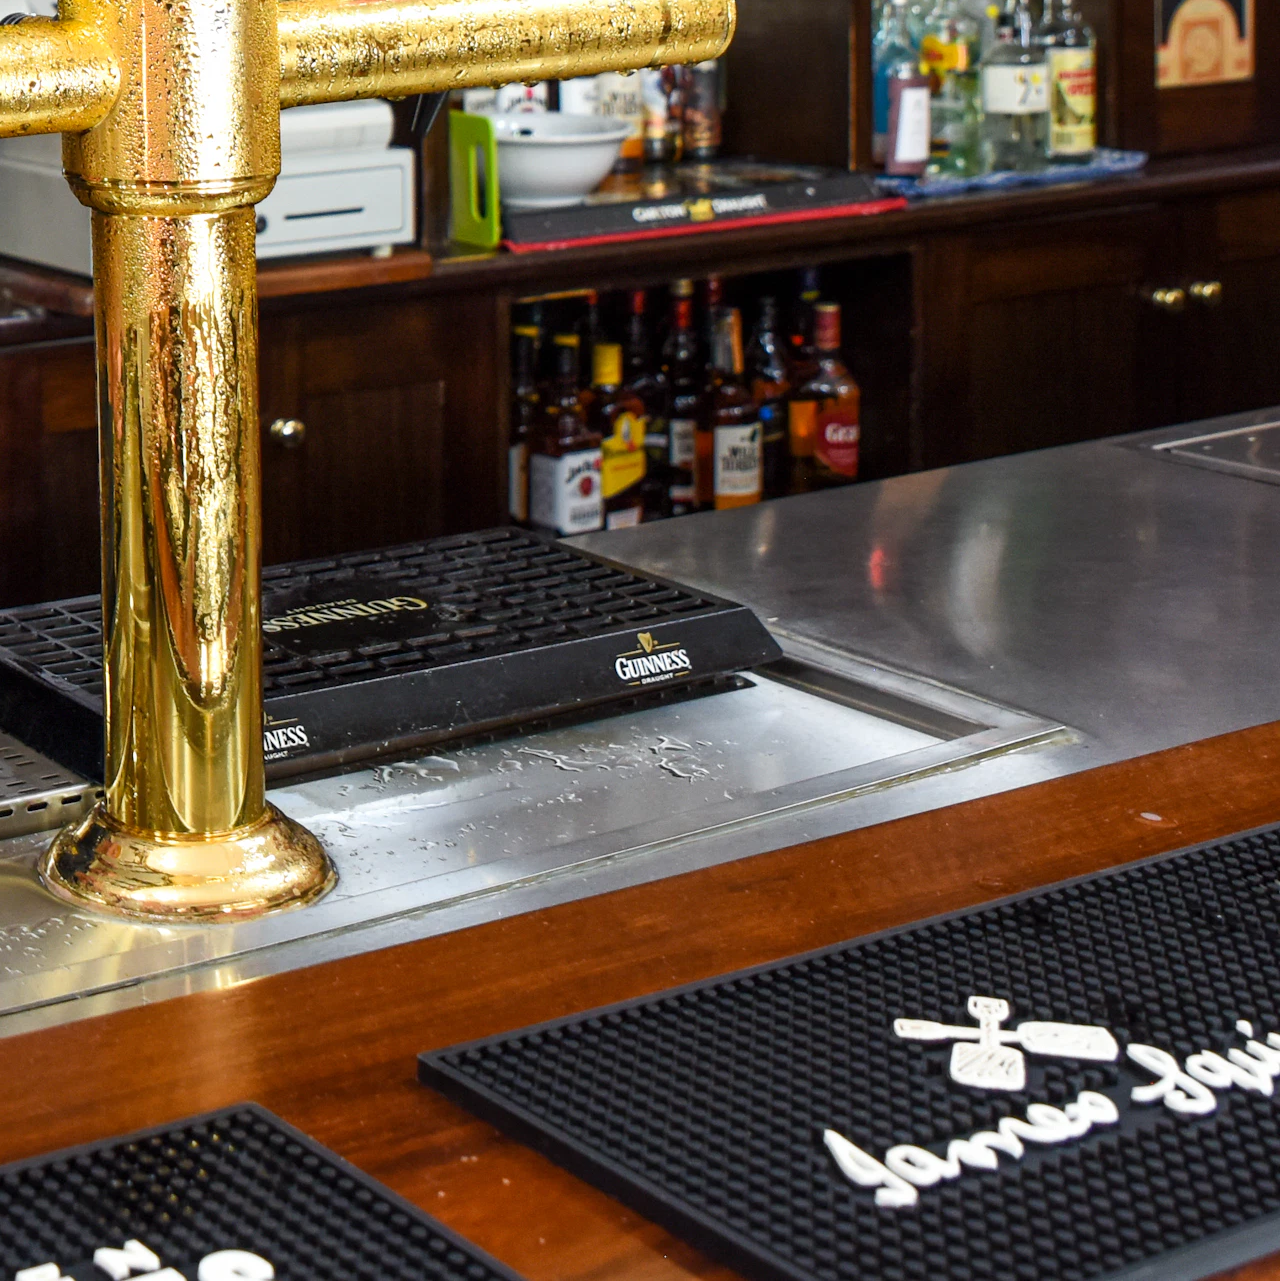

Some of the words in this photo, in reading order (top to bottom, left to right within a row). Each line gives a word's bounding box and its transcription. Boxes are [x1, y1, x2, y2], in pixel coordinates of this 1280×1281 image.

[262, 595, 428, 633] GUINNESS
[615, 649, 690, 681] GUINNESS
[641, 672, 674, 685] DRAUGHT
[264, 724, 307, 752] NESS
[823, 1089, 1120, 1208] James
